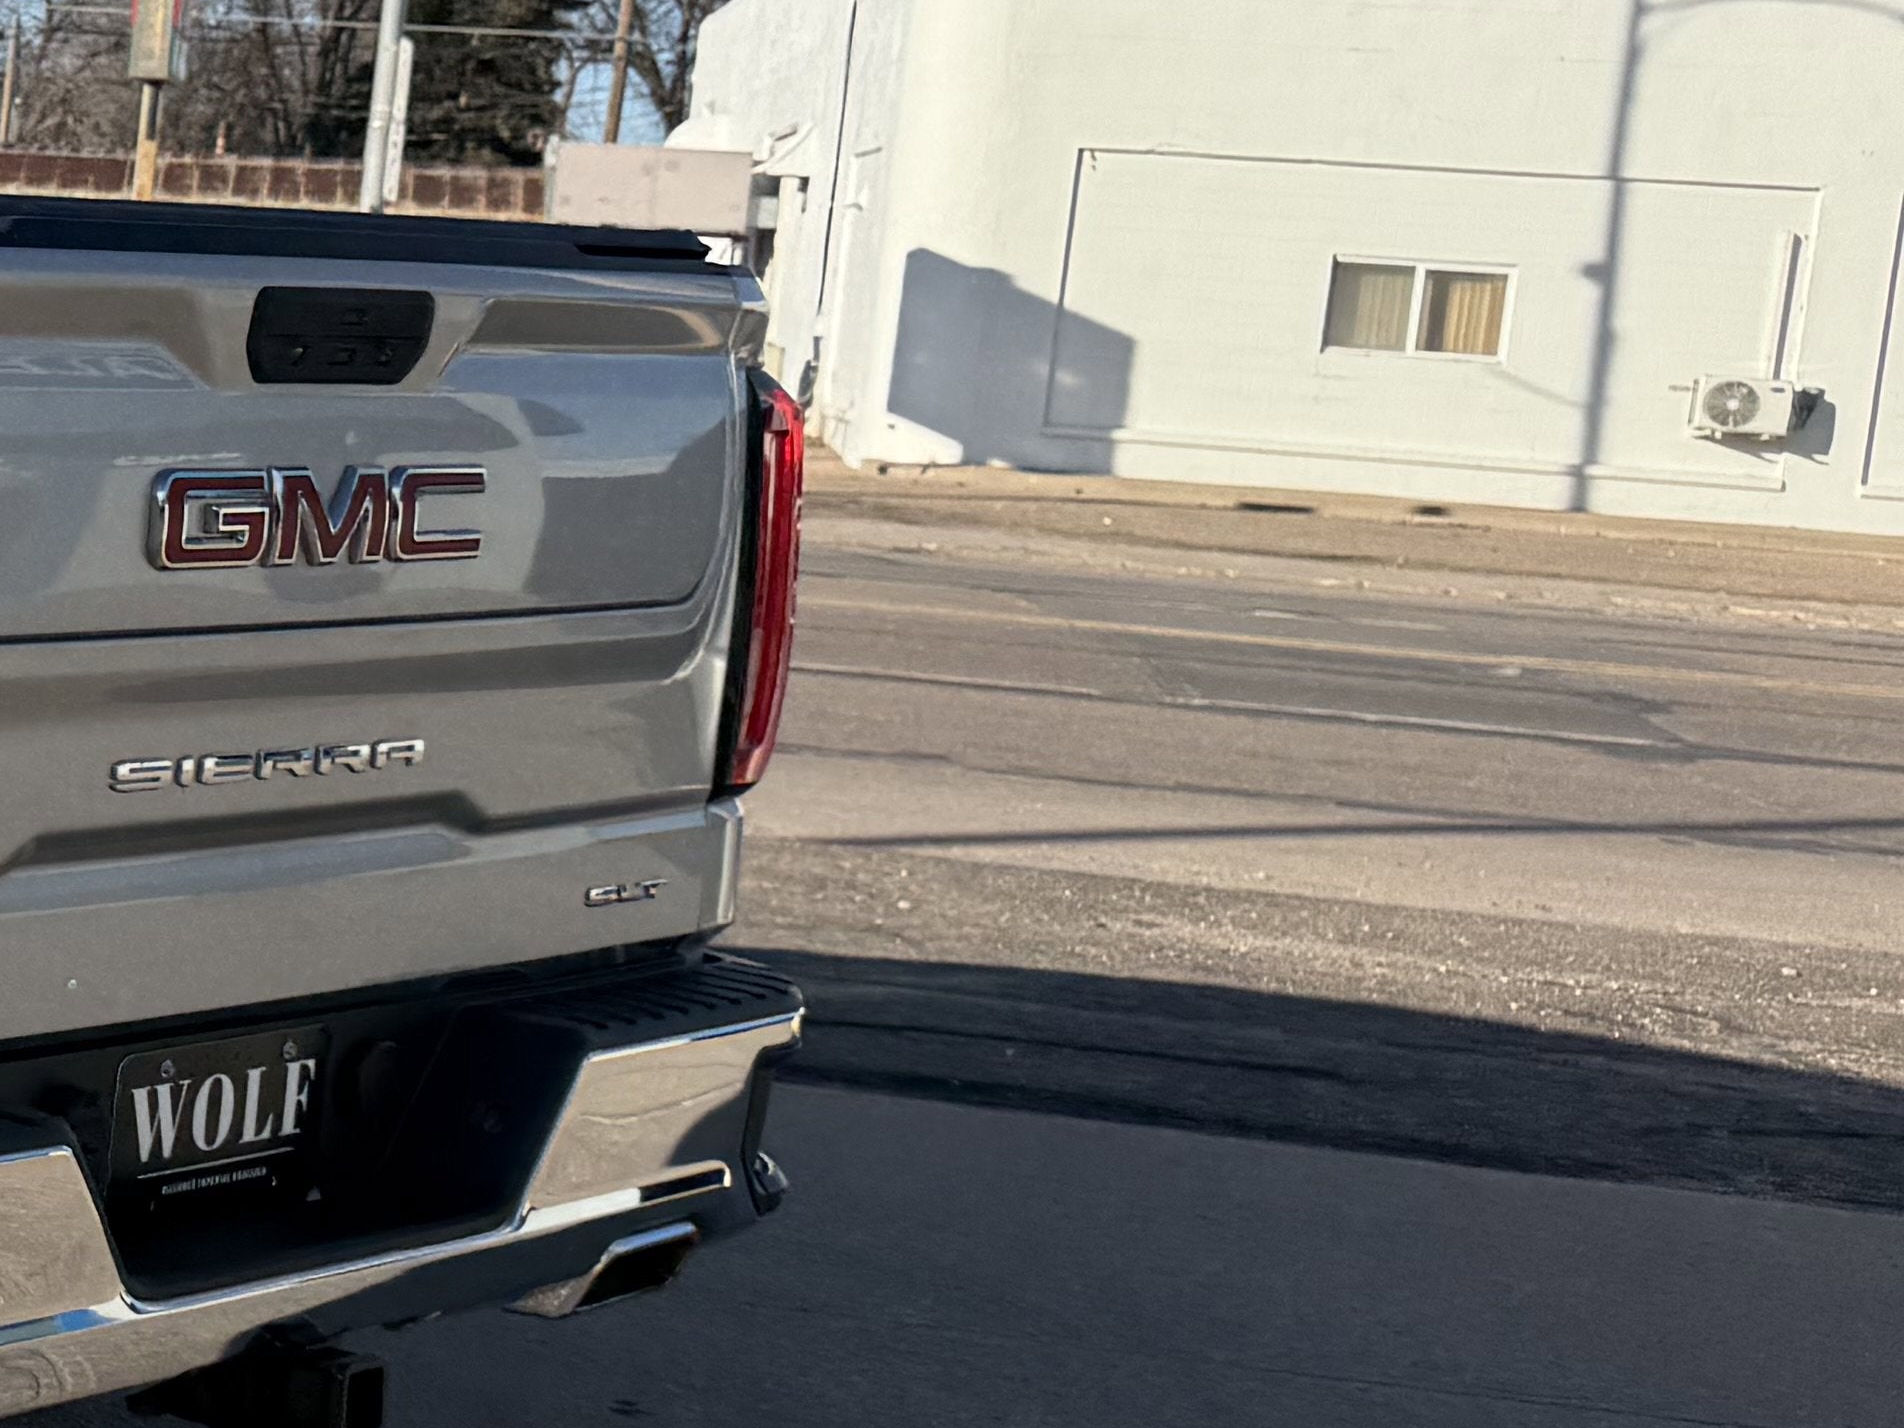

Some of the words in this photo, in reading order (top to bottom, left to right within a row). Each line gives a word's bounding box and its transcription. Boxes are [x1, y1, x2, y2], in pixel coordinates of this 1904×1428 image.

[146, 463, 488, 572] GMC
[108, 738, 426, 794] SIERRA
[583, 877, 669, 908] SLT
[130, 1058, 317, 1164] WOLF
